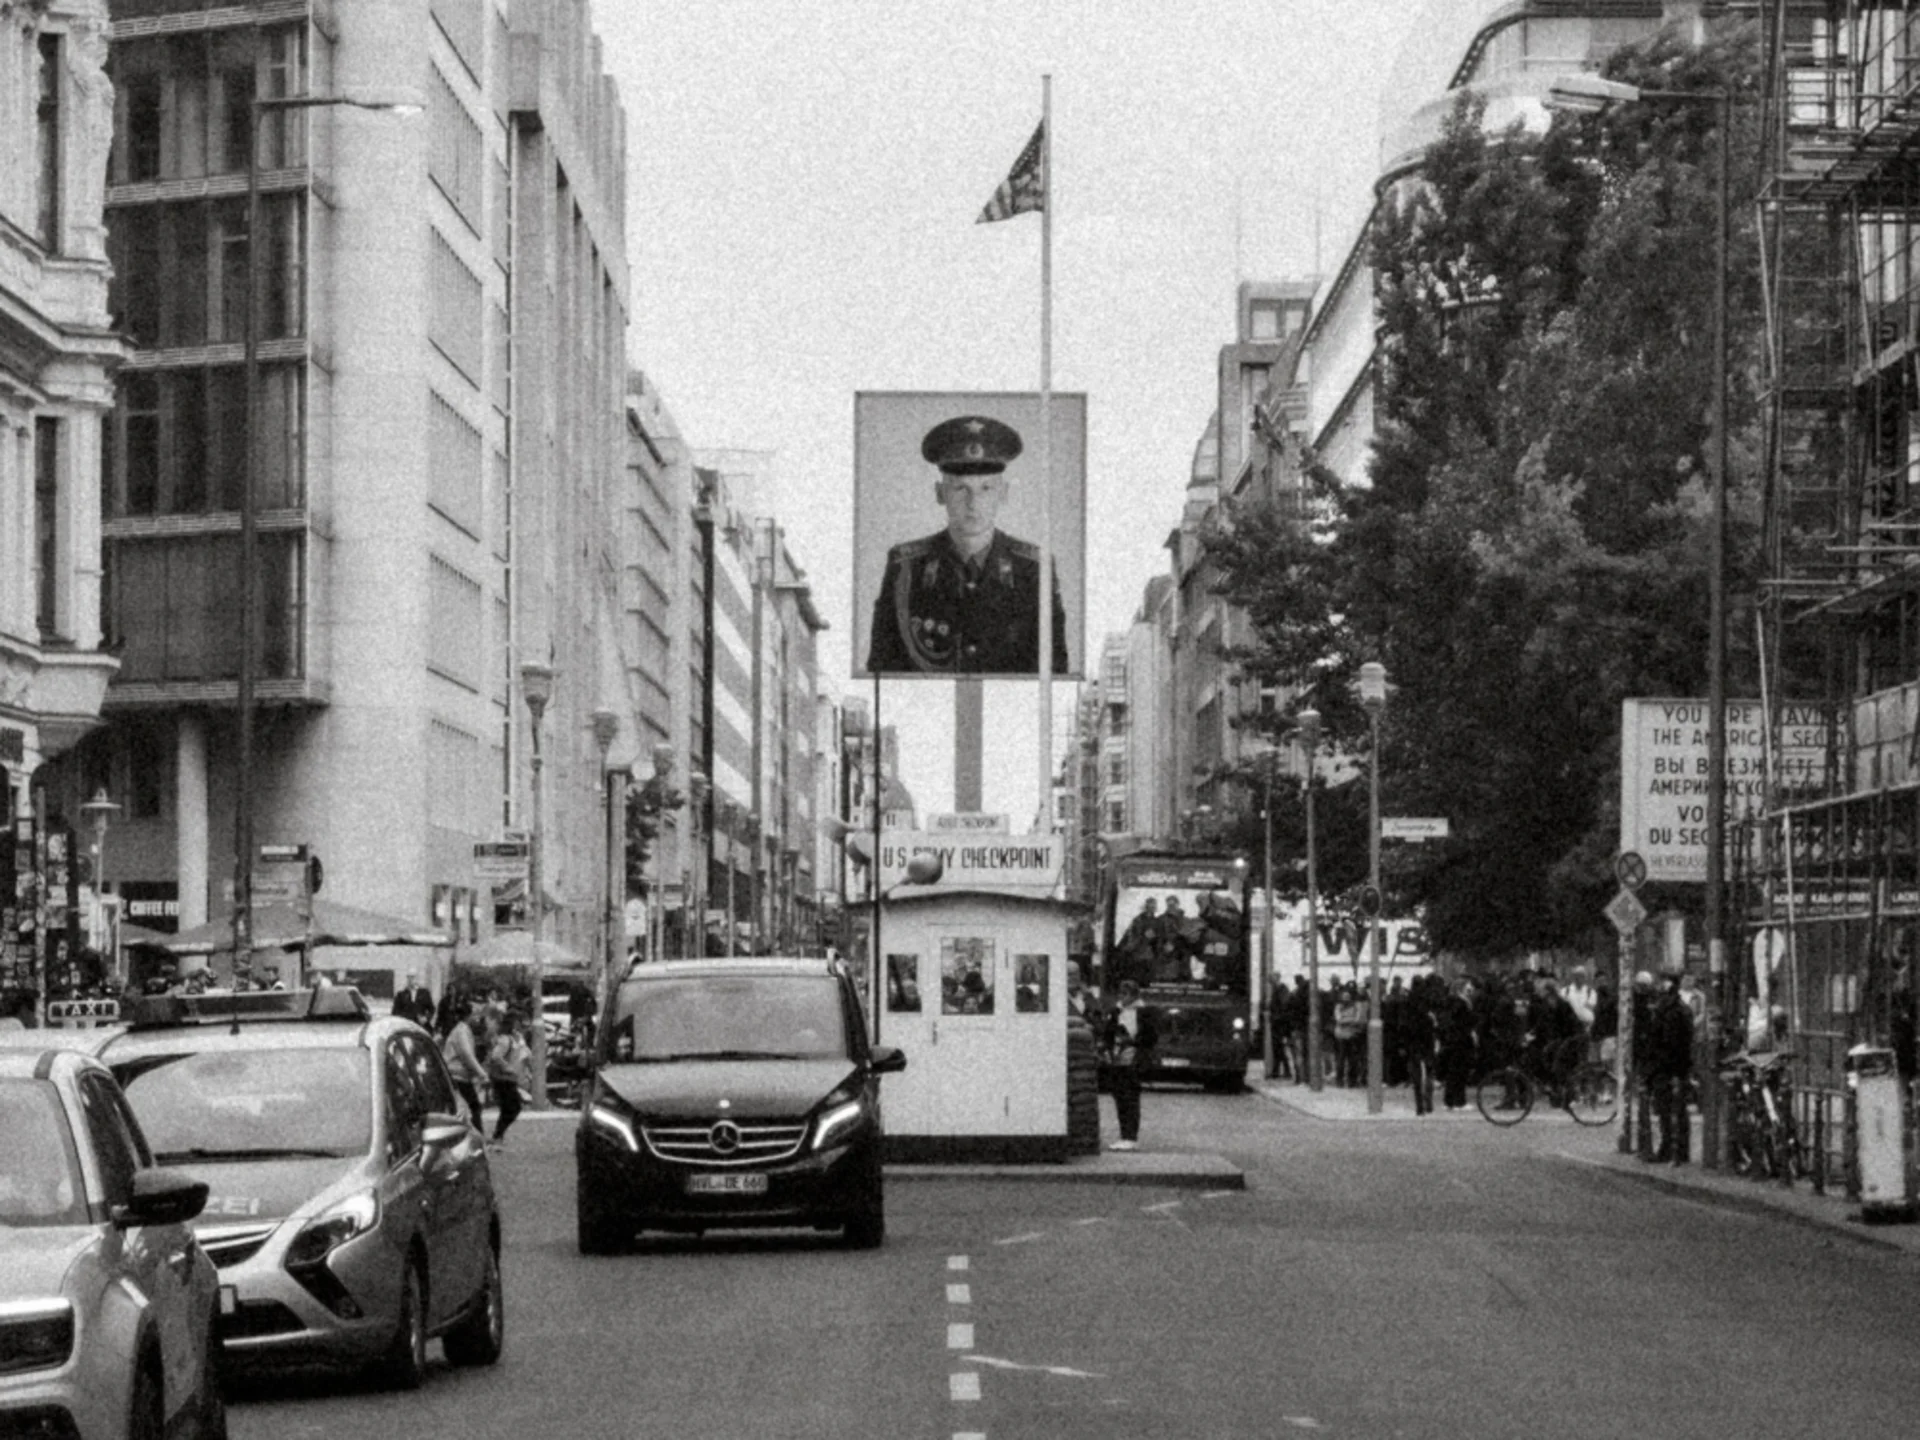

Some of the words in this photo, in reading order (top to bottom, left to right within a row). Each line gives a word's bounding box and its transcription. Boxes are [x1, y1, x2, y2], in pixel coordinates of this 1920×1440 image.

[1662, 705, 1702, 724] YOU
[1728, 706, 1752, 724] RE
[1653, 728, 1681, 746] THE
[1678, 805, 1731, 822] VOS
[1649, 828, 1671, 845] DU
[883, 847, 893, 868] U
[898, 847, 906, 868] S
[961, 847, 1051, 868] CHECKPOINT
[59, 1001, 107, 1016] TAXI
